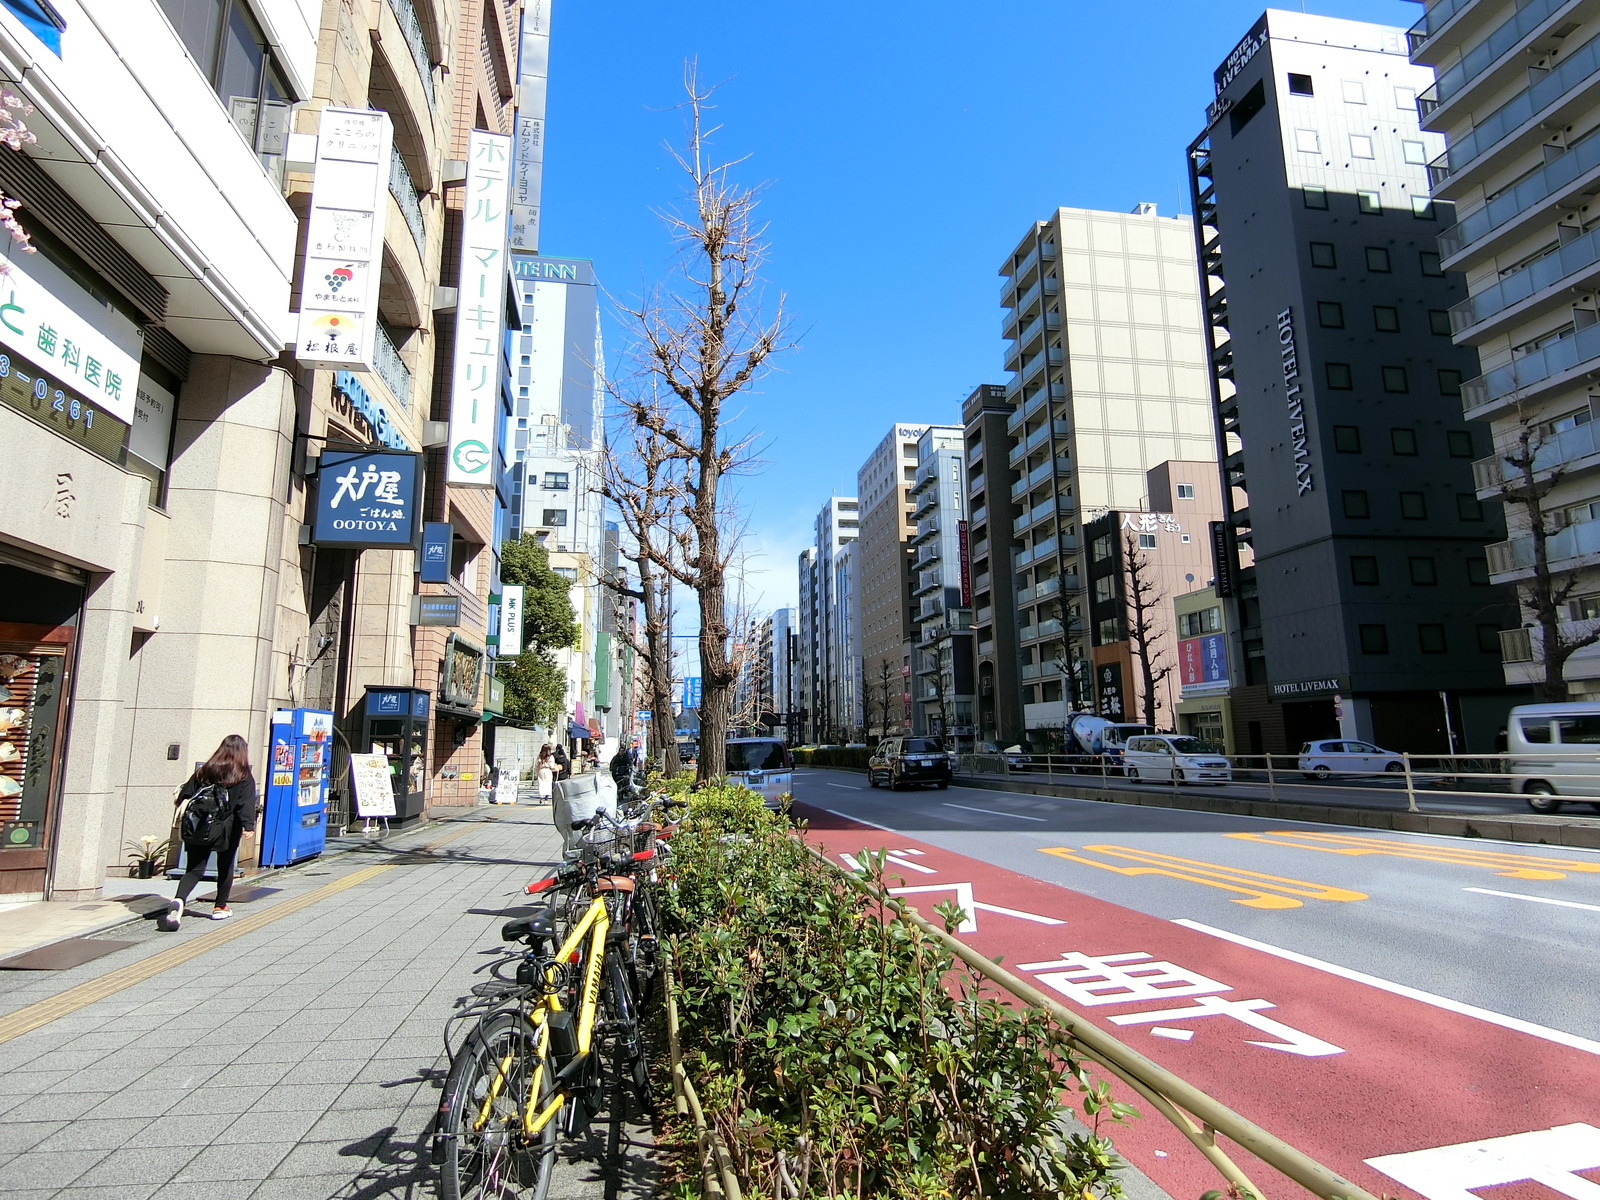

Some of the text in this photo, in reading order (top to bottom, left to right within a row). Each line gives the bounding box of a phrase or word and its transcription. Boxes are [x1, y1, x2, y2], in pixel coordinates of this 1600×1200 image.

[1226, 35, 1254, 69] HOTEL
[333, 127, 375, 138] こころの
[532, 121, 541, 147] 株式会社
[326, 139, 378, 152] クリニック
[543, 262, 576, 280] INN
[465, 138, 505, 425] ホテル マーキュリー
[1276, 307, 1299, 388] HOTEL
[329, 463, 406, 510] 大戸屋
[332, 518, 398, 532] OOTOYA
[1119, 512, 1159, 532] 人形
[508, 597, 517, 610] MK
[506, 611, 516, 633] PLUS
[1208, 638, 1220, 680] 五月人形
[1273, 683, 1300, 694] HOTEL
[499, 769, 512, 778] MK
[503, 775, 519, 783] PLUS
[587, 952, 605, 1006] YAMAHA
